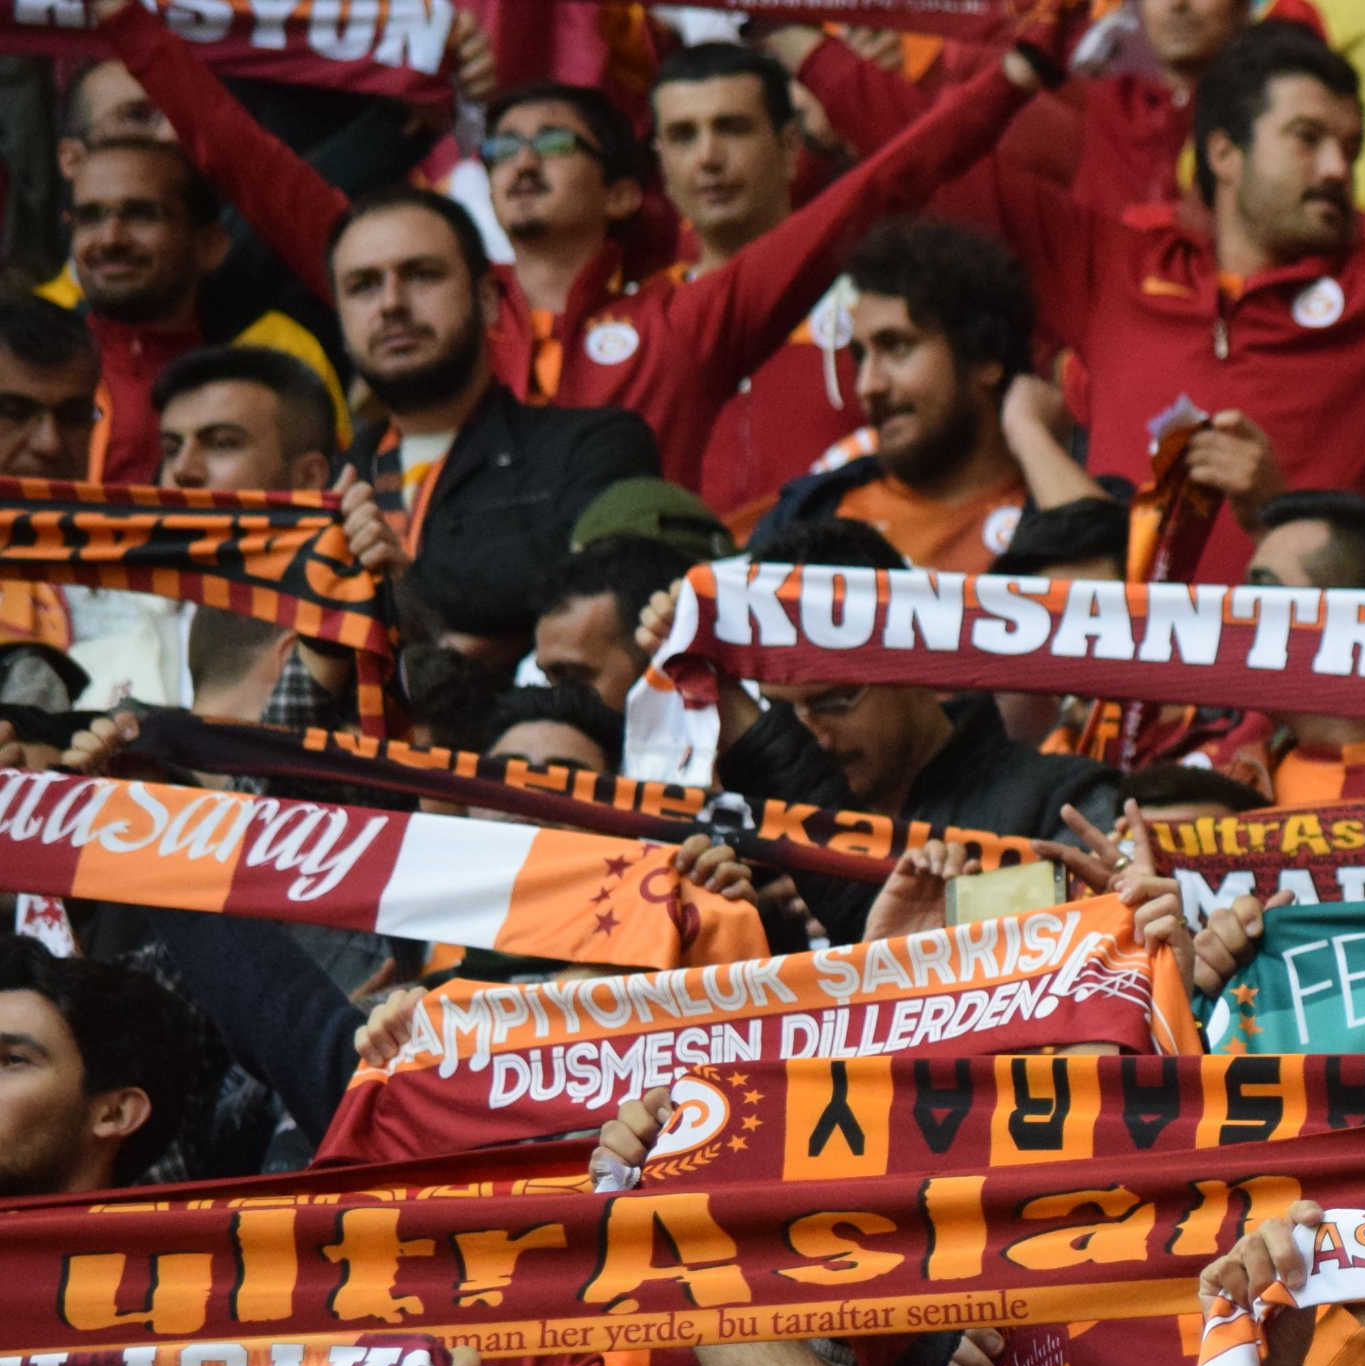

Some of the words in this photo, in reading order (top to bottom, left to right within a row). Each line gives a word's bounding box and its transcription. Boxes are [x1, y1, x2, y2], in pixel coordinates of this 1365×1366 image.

[392, 953, 799, 1081] AMPİYONLUK
[781, 973, 1060, 1064] DİLLERDEN!
[55, 1172, 1304, 1336] ultrAslan
[537, 1319, 596, 1351] her
[604, 1314, 704, 1354] yerde,
[716, 1306, 760, 1340] bu
[770, 1299, 896, 1336] taraftar
[906, 1289, 1030, 1327] seninle
